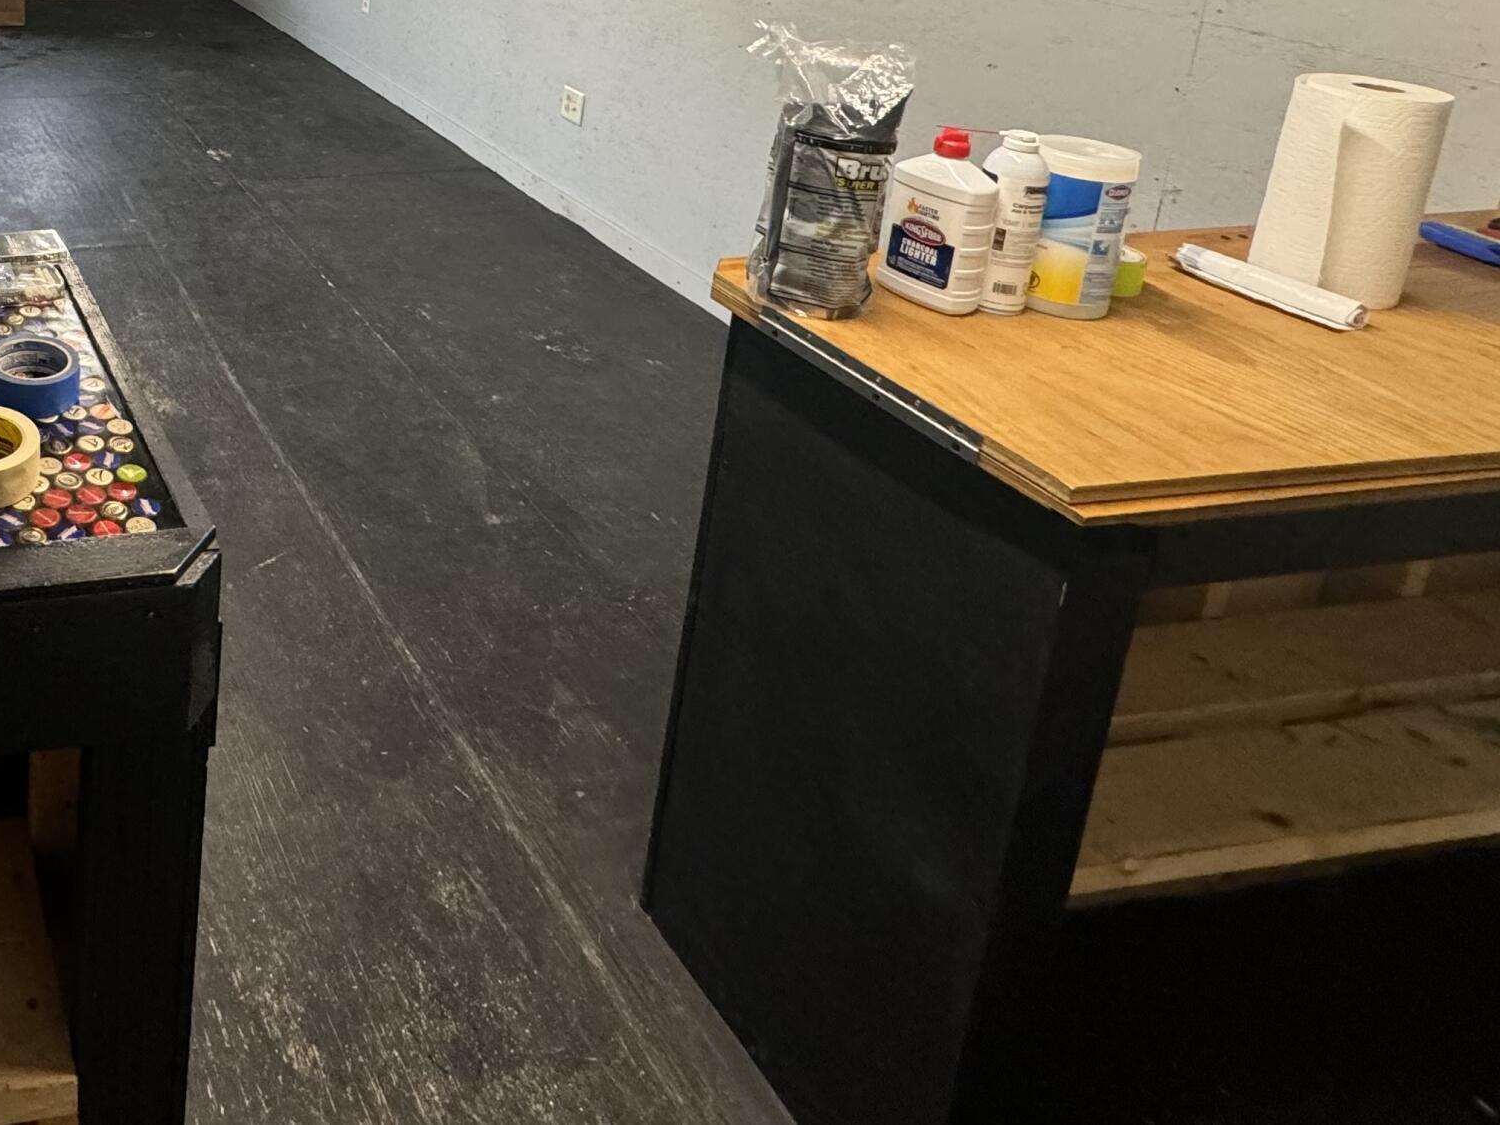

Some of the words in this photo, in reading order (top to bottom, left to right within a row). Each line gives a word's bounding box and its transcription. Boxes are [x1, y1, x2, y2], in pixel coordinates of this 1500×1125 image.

[836, 157, 890, 181] Bru
[904, 222, 943, 242] KINGSFORD
[900, 243, 938, 266] LIGHTER
[901, 237, 939, 257] CHARCOAL
